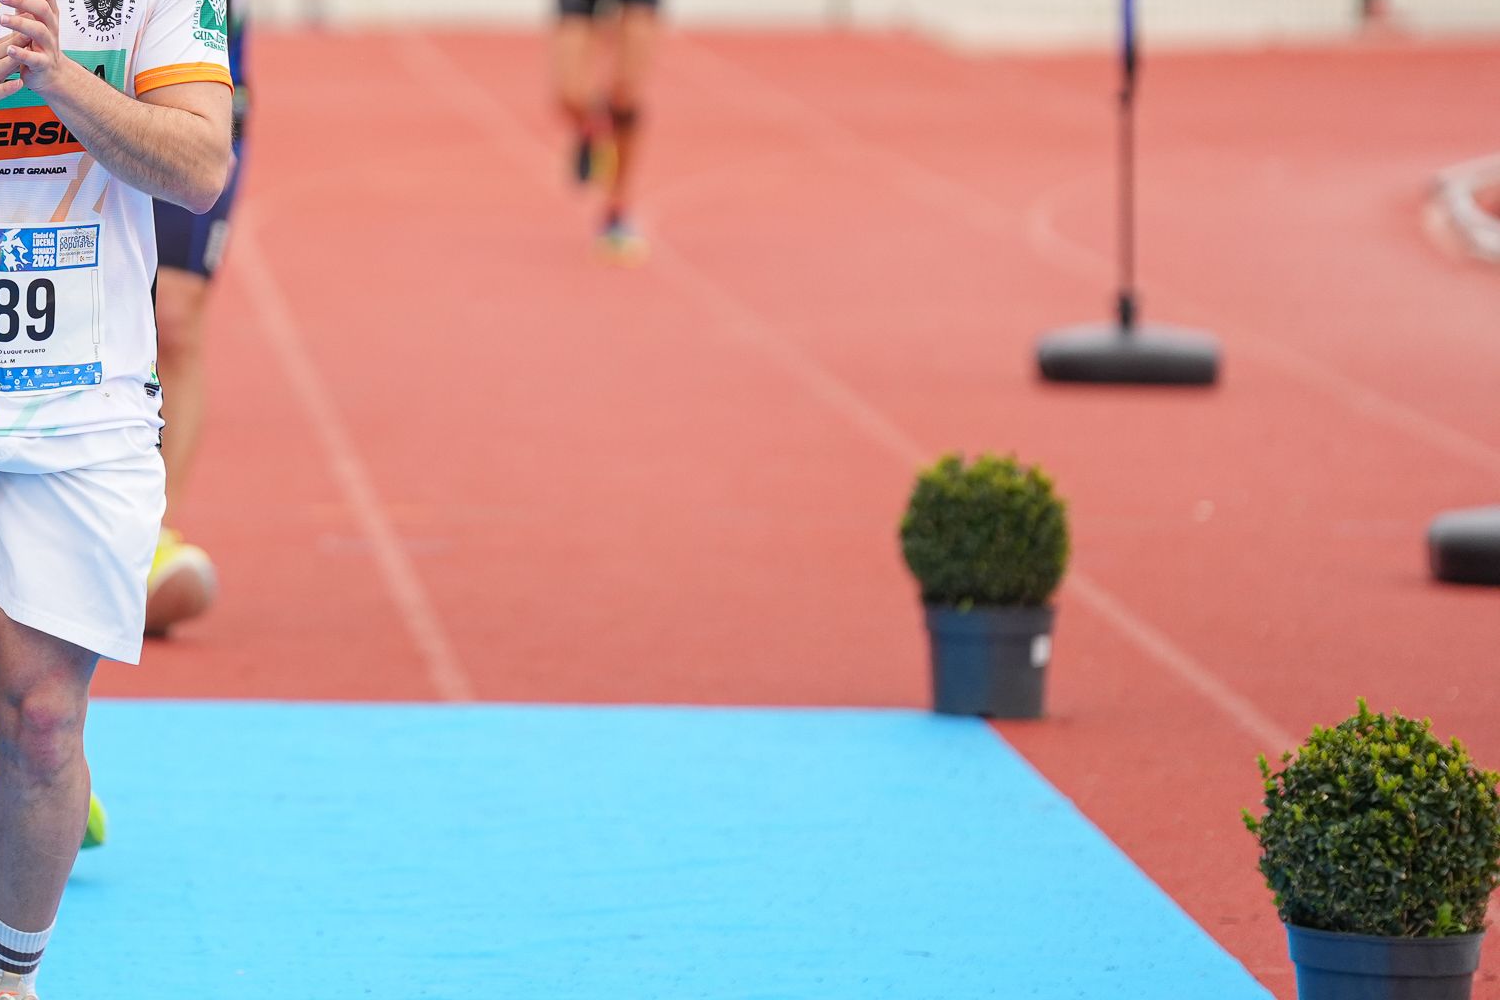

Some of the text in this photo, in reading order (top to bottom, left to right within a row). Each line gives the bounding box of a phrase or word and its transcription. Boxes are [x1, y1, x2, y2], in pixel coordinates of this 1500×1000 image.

[27, 167, 67, 175] GRANADA
[60, 235, 89, 243] carreras
[60, 240, 94, 251] populares
[32, 255, 55, 267] 2026
